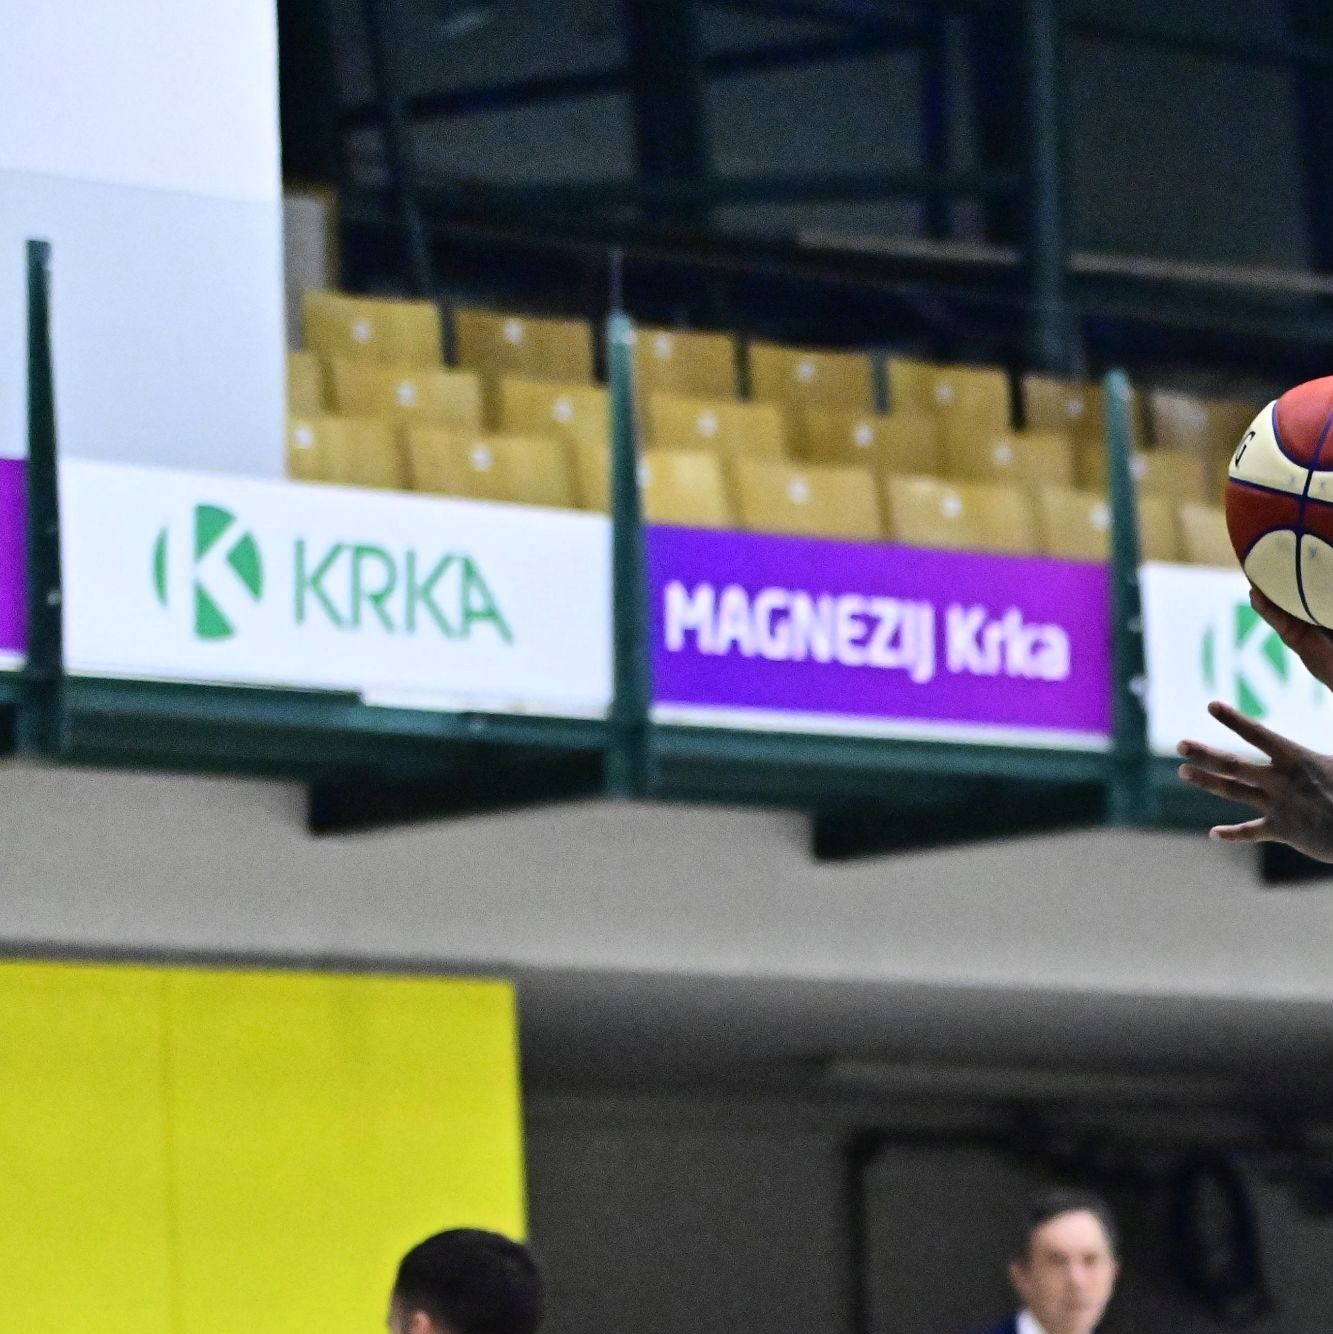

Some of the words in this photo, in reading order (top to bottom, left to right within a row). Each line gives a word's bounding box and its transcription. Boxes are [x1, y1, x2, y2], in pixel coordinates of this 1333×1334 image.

[294, 536, 515, 645] KRKA
[663, 579, 937, 684] MAGNEZIJ
[945, 603, 1072, 682] Krka
